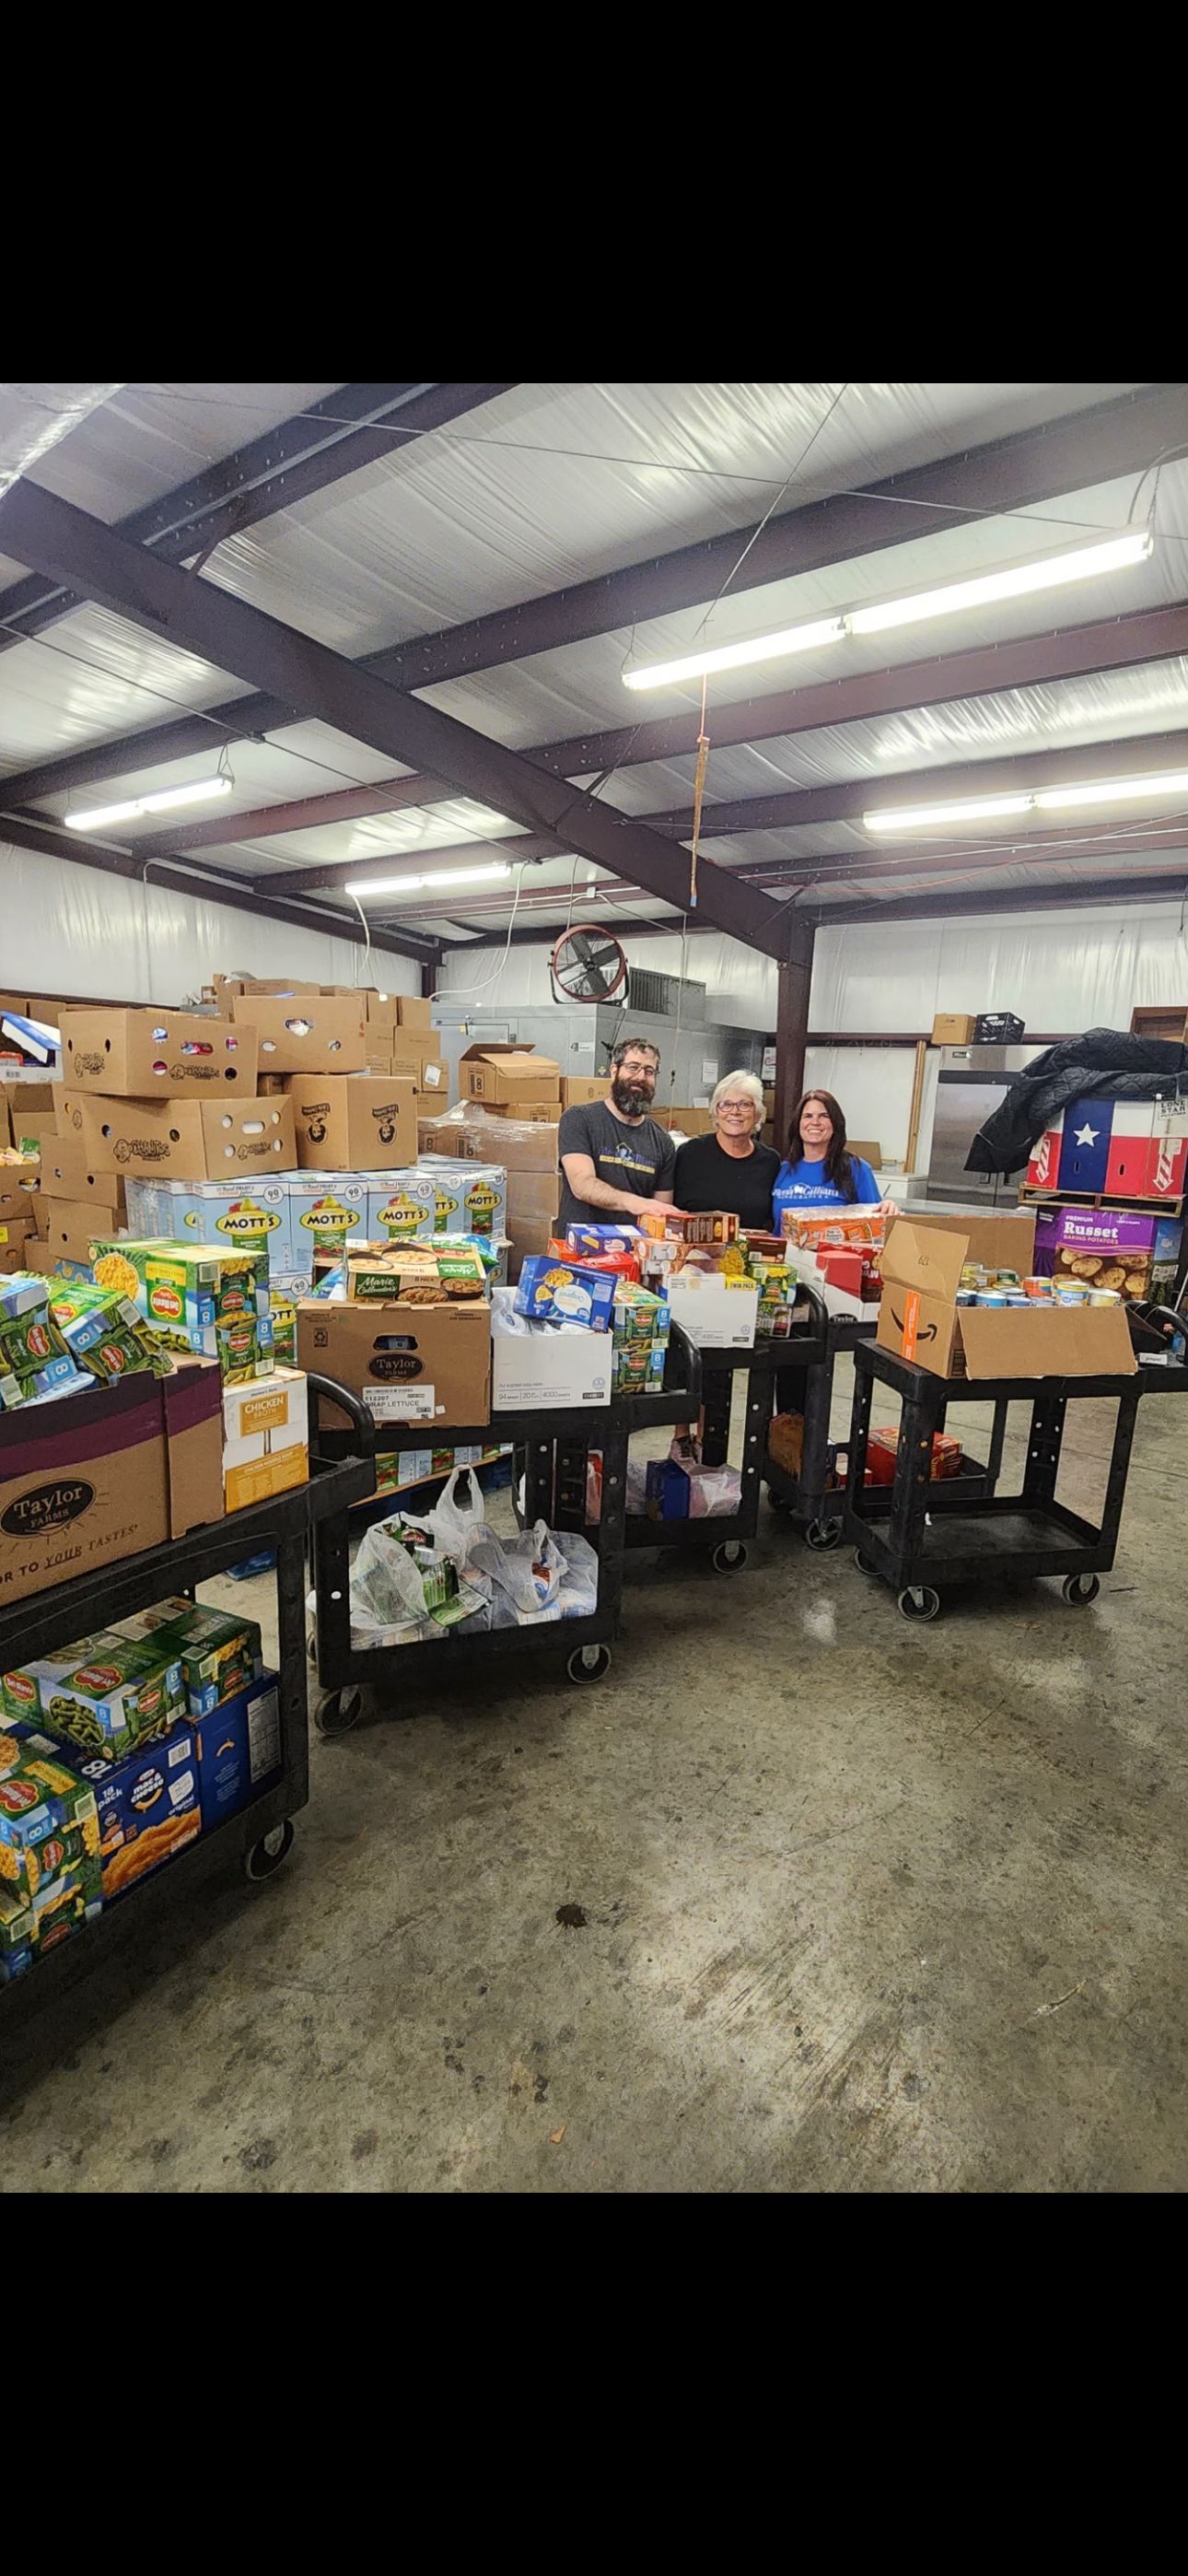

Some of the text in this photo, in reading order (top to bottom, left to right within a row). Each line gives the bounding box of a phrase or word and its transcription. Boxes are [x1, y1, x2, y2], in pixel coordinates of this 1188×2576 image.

[1161, 1100, 1185, 1108] LONE
[1063, 1222, 1119, 1238] Russet
[361, 1276, 396, 1286] Marie
[203, 1311, 210, 1323] 8
[661, 1309, 668, 1319] 8
[261, 1322, 268, 1334] 8
[77, 1332, 90, 1345] 8
[193, 1332, 201, 1344] 8
[654, 1353, 661, 1363] 8
[55, 1363, 68, 1375] 8
[376, 1359, 417, 1370] Taylor
[245, 1396, 284, 1414] CHICKEN
[14, 1487, 83, 1519] Taylor
[30, 1508, 70, 1528] FARMS
[18, 1562, 39, 1576] TO
[43, 1545, 83, 1568] YOUR
[102, 1786, 114, 1798] 18
[98, 1788, 123, 1811] pack
[29, 1826, 43, 1840] 8
